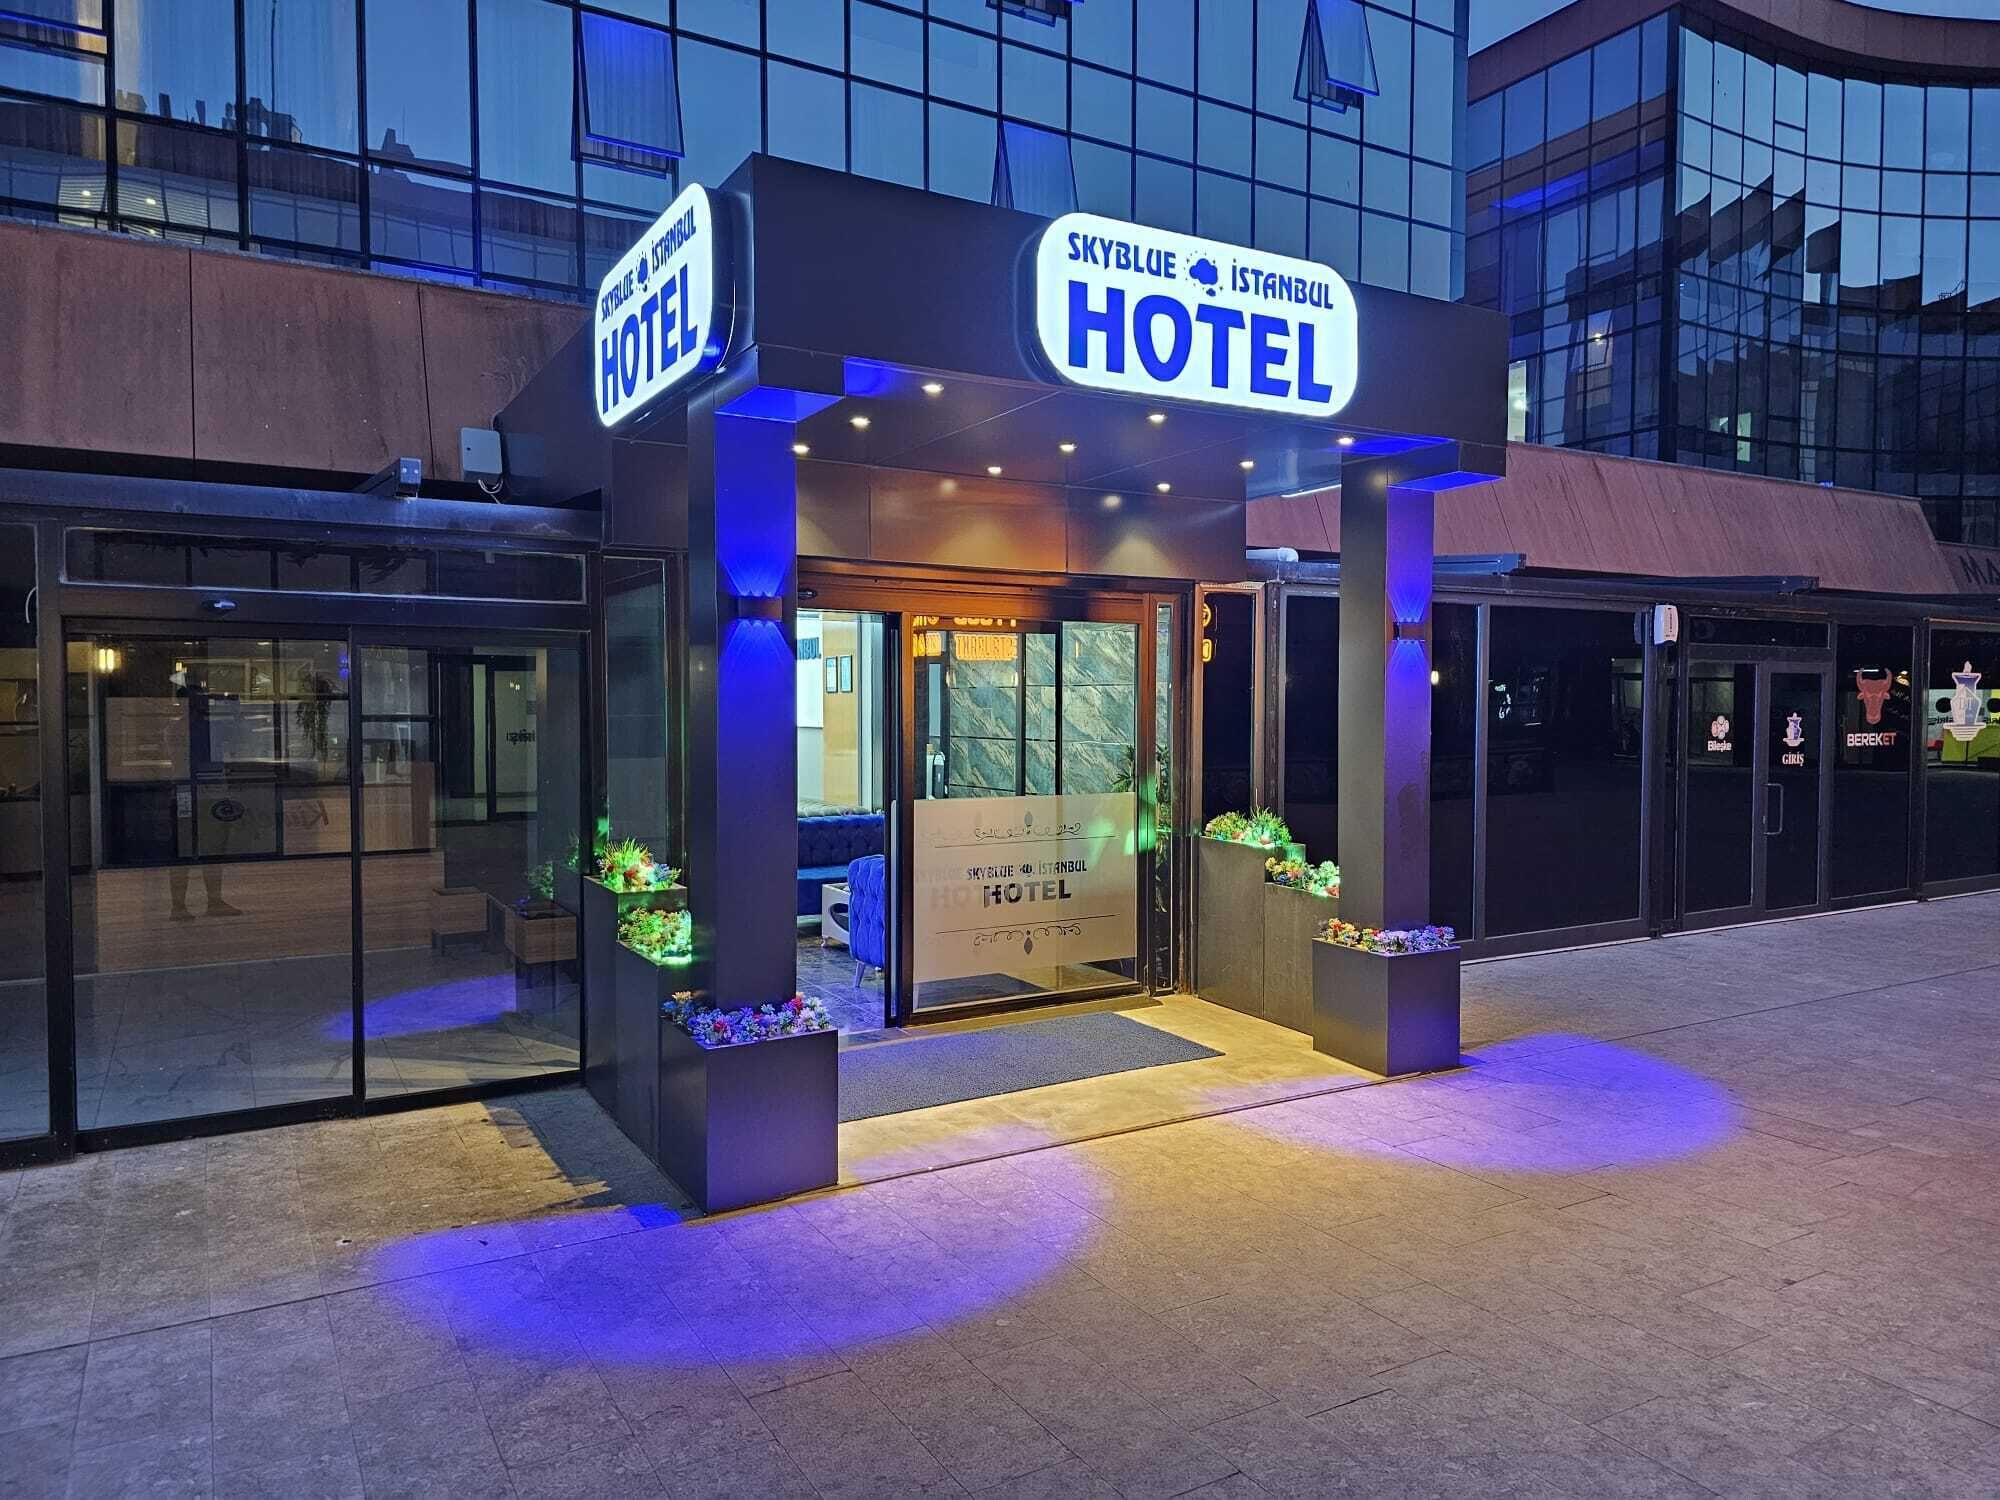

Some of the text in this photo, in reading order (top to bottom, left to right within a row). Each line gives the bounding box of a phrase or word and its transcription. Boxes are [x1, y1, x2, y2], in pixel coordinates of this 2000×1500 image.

[602, 206, 697, 323] SKYBLUE İSTANBUL
[1068, 232, 1334, 310] SKYBLUE İSTANBUL
[602, 263, 698, 416] HOTEL
[1068, 280, 1333, 404] HOTEL
[1782, 751, 1805, 767] GİRİŞ
[1847, 732, 1897, 747] BEREKET
[967, 864, 1014, 880] SKYBLUE
[983, 879, 1072, 908] HOTEL
